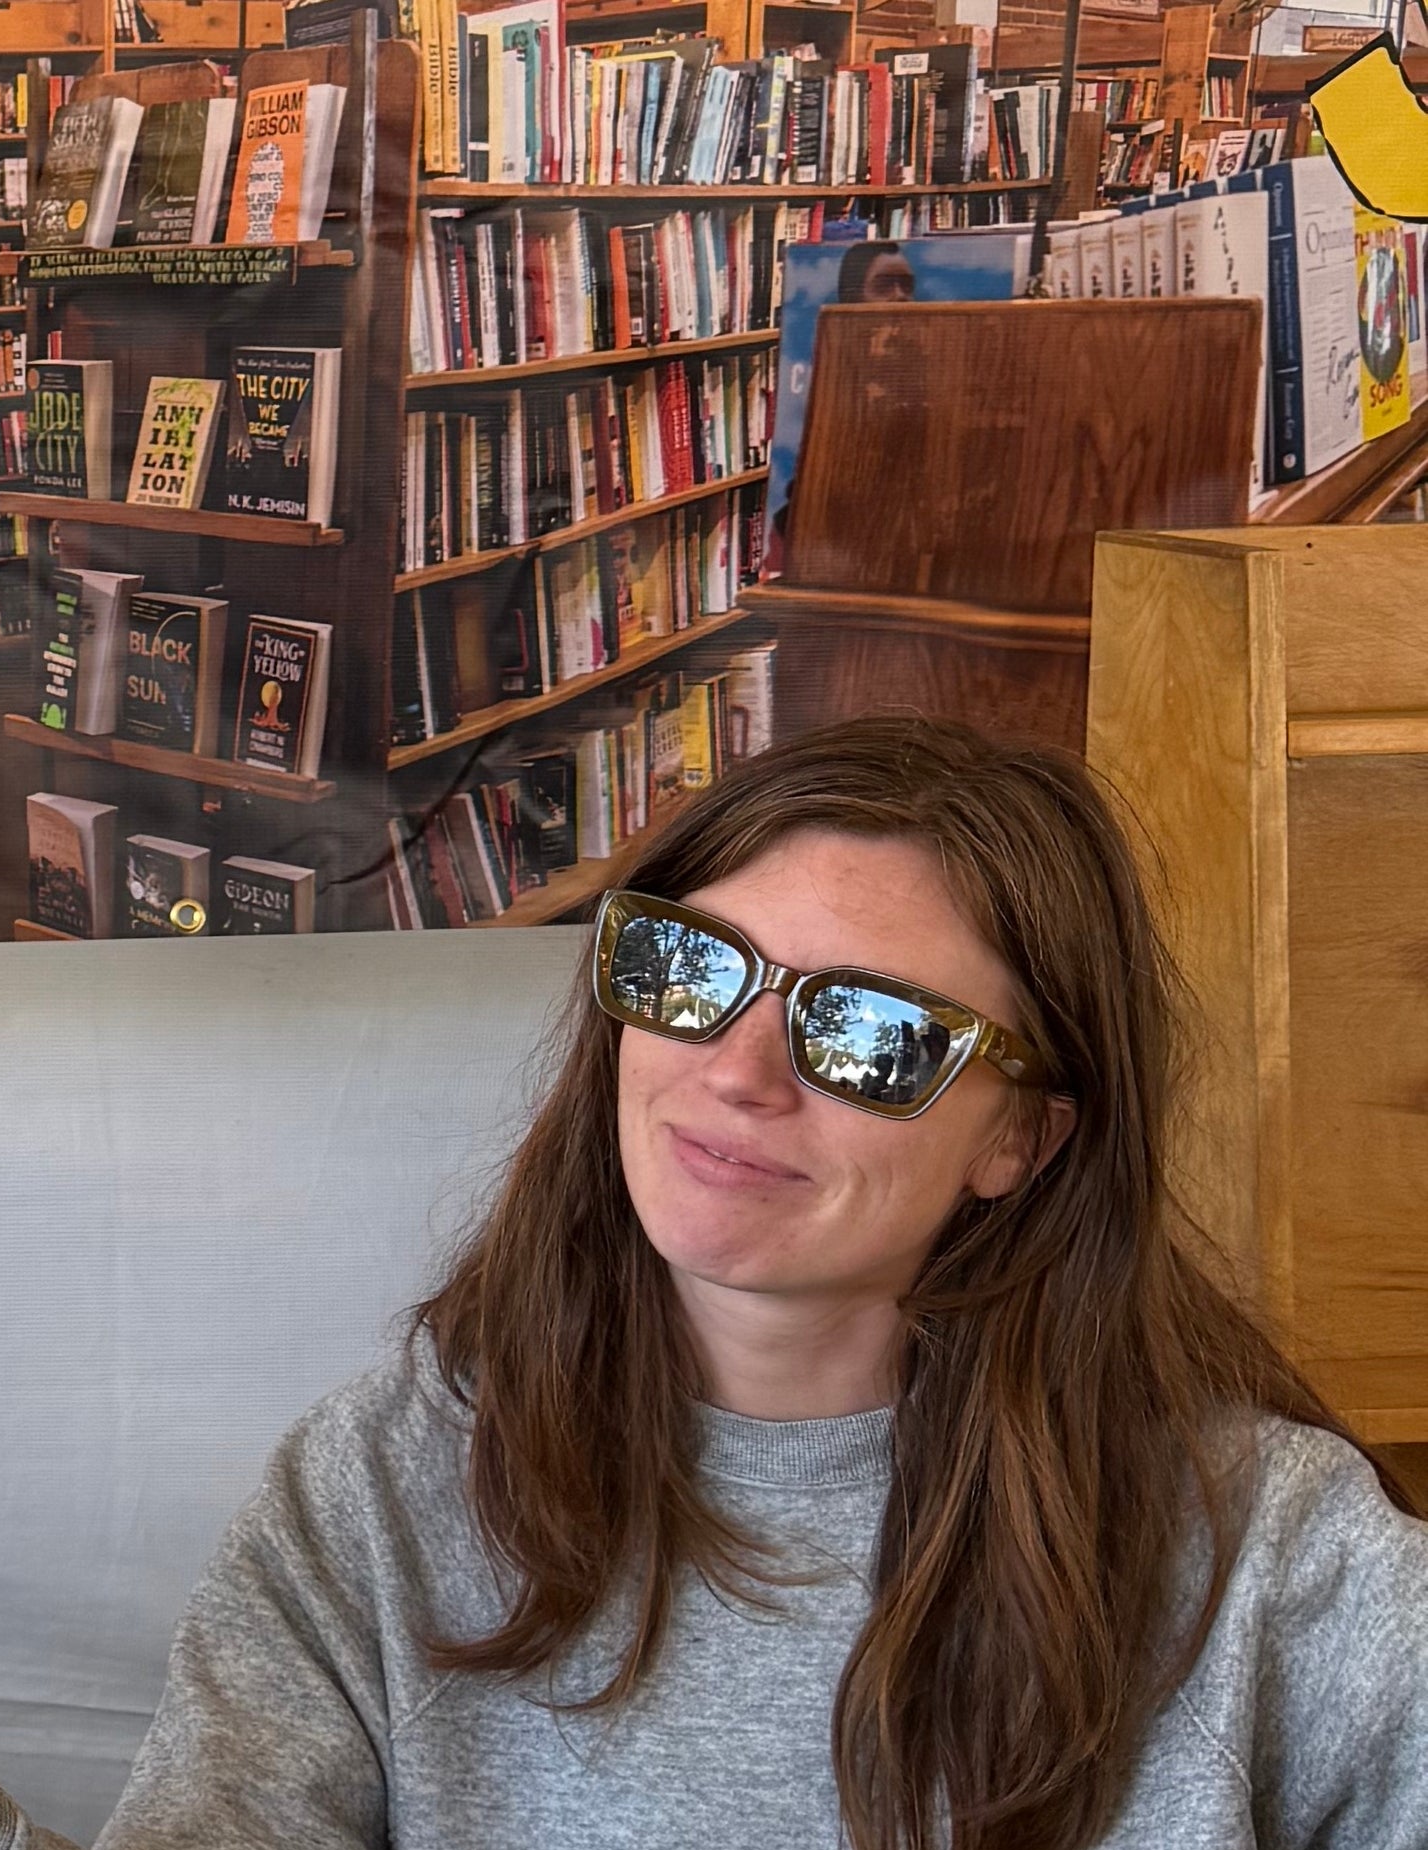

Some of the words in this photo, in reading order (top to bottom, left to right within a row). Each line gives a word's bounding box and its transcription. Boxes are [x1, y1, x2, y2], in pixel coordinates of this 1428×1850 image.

[249, 91, 304, 118] WILLIAM
[246, 115, 301, 140] GIBSON
[236, 374, 268, 398] THE
[271, 376, 311, 402] CITY
[1369, 373, 1404, 408] SONG
[29, 391, 82, 431] JADE
[258, 404, 280, 421] WE
[248, 423, 291, 438] BECAME
[35, 432, 79, 474] CITY
[139, 473, 186, 494] ION
[256, 497, 306, 516] JEMISIN
[129, 630, 192, 665] BLACK
[263, 634, 299, 661] KING
[253, 654, 304, 683] YELLOW
[127, 675, 166, 705] SUN
